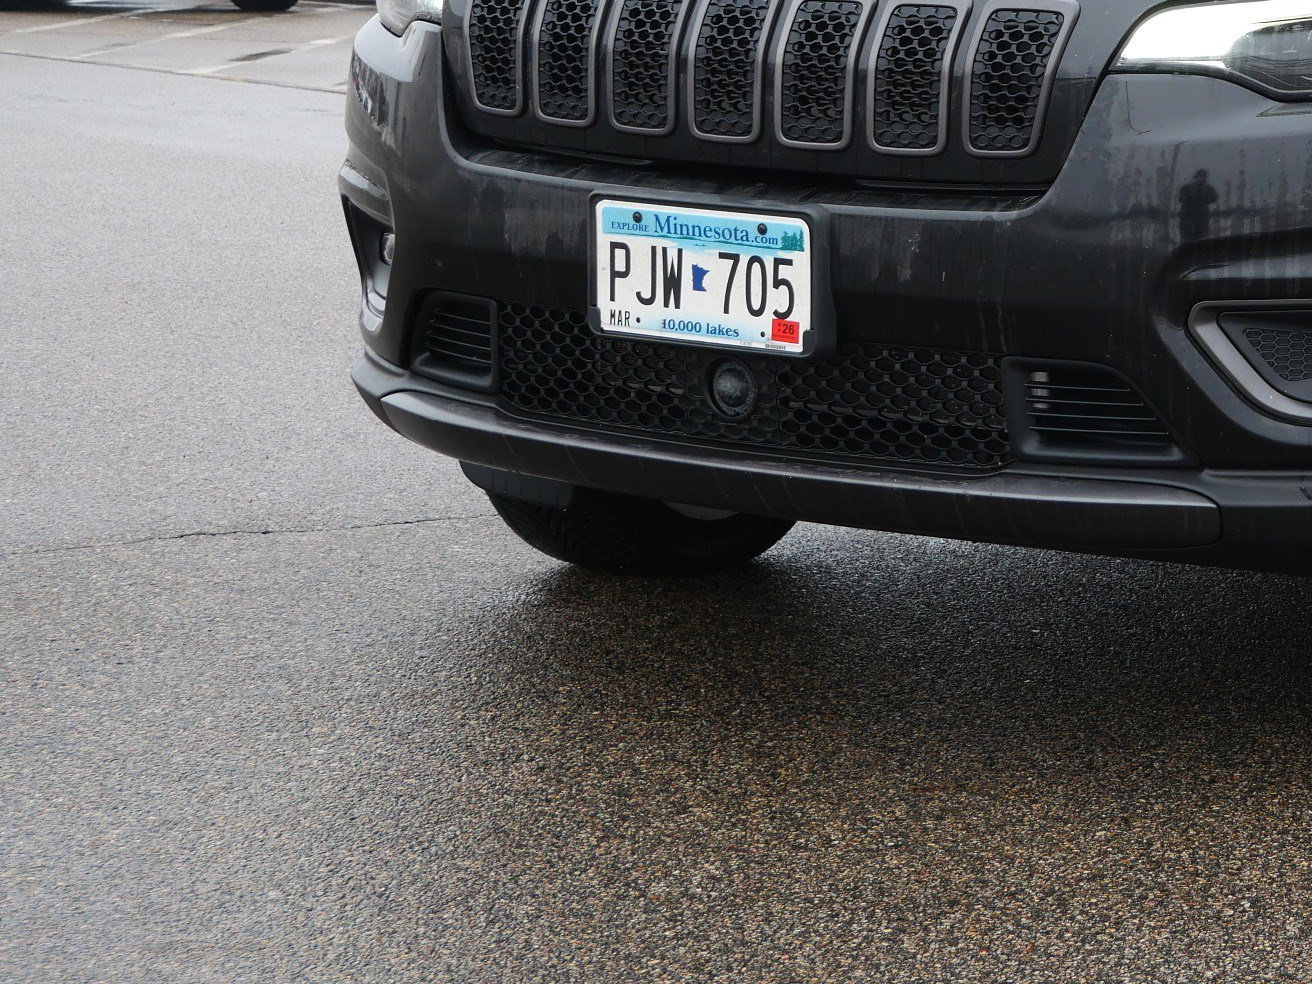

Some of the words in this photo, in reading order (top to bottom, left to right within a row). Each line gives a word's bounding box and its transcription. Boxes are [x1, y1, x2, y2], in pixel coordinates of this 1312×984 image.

[611, 221, 650, 233] EXPLORE
[654, 214, 779, 246] Minnesota.com
[609, 241, 684, 310] PJW
[718, 251, 795, 320] 705
[610, 309, 631, 327] MAR
[661, 318, 702, 333] 10,000
[705, 323, 740, 338] lakes
[782, 323, 795, 335] 26
